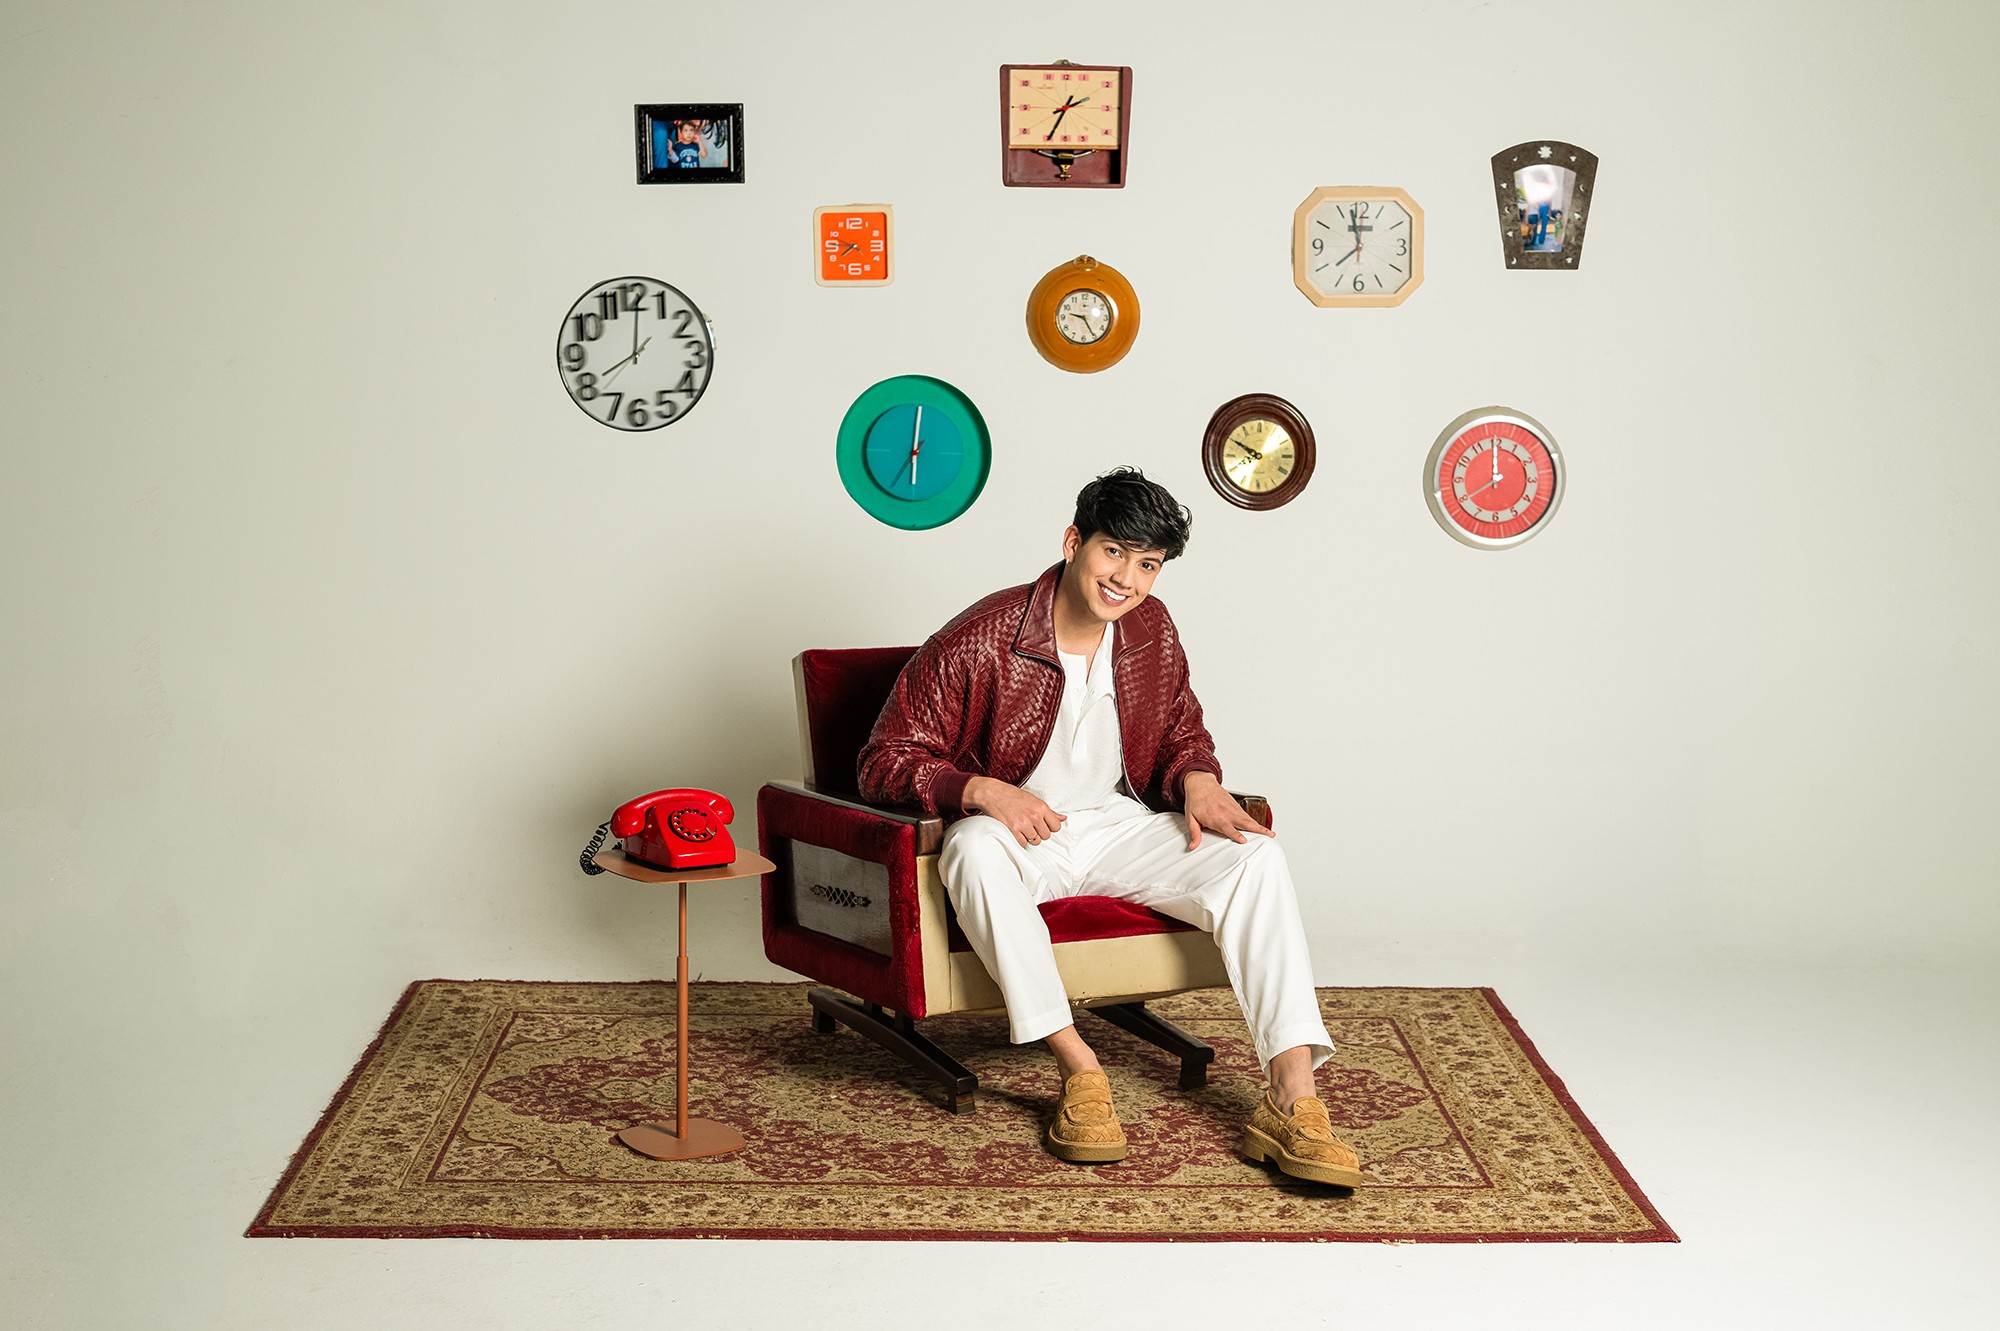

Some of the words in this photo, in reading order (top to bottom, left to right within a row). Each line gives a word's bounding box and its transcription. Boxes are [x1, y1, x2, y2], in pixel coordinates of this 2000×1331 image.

[1350, 201, 1369, 218] 12
[846, 218, 862, 229] 12
[825, 240, 839, 252] 9
[870, 240, 884, 252] 3
[1312, 238, 1323, 256] 9
[1397, 238, 1407, 256] 3
[848, 263, 862, 275] 6
[1353, 274, 1364, 291] 6
[595, 291, 618, 320] 11
[613, 283, 648, 311] 12
[652, 290, 666, 319] 1
[570, 313, 603, 341] 10
[671, 310, 695, 338] 2
[564, 343, 585, 372] 9
[683, 340, 705, 368] 3
[575, 372, 598, 401] 8
[672, 370, 698, 398] 4
[601, 392, 623, 421] 7
[627, 398, 648, 427] 6
[655, 390, 677, 418] 5
[1472, 443, 1484, 454] 11
[1491, 438, 1502, 448] 12
[1512, 444, 1517, 452] 1
[1458, 456, 1470, 468] 10
[1524, 457, 1532, 466] 2
[1459, 495, 1468, 503] 8
[1474, 508, 1481, 516] 7
[1492, 512, 1499, 521] 6
[1510, 507, 1518, 516] 5
